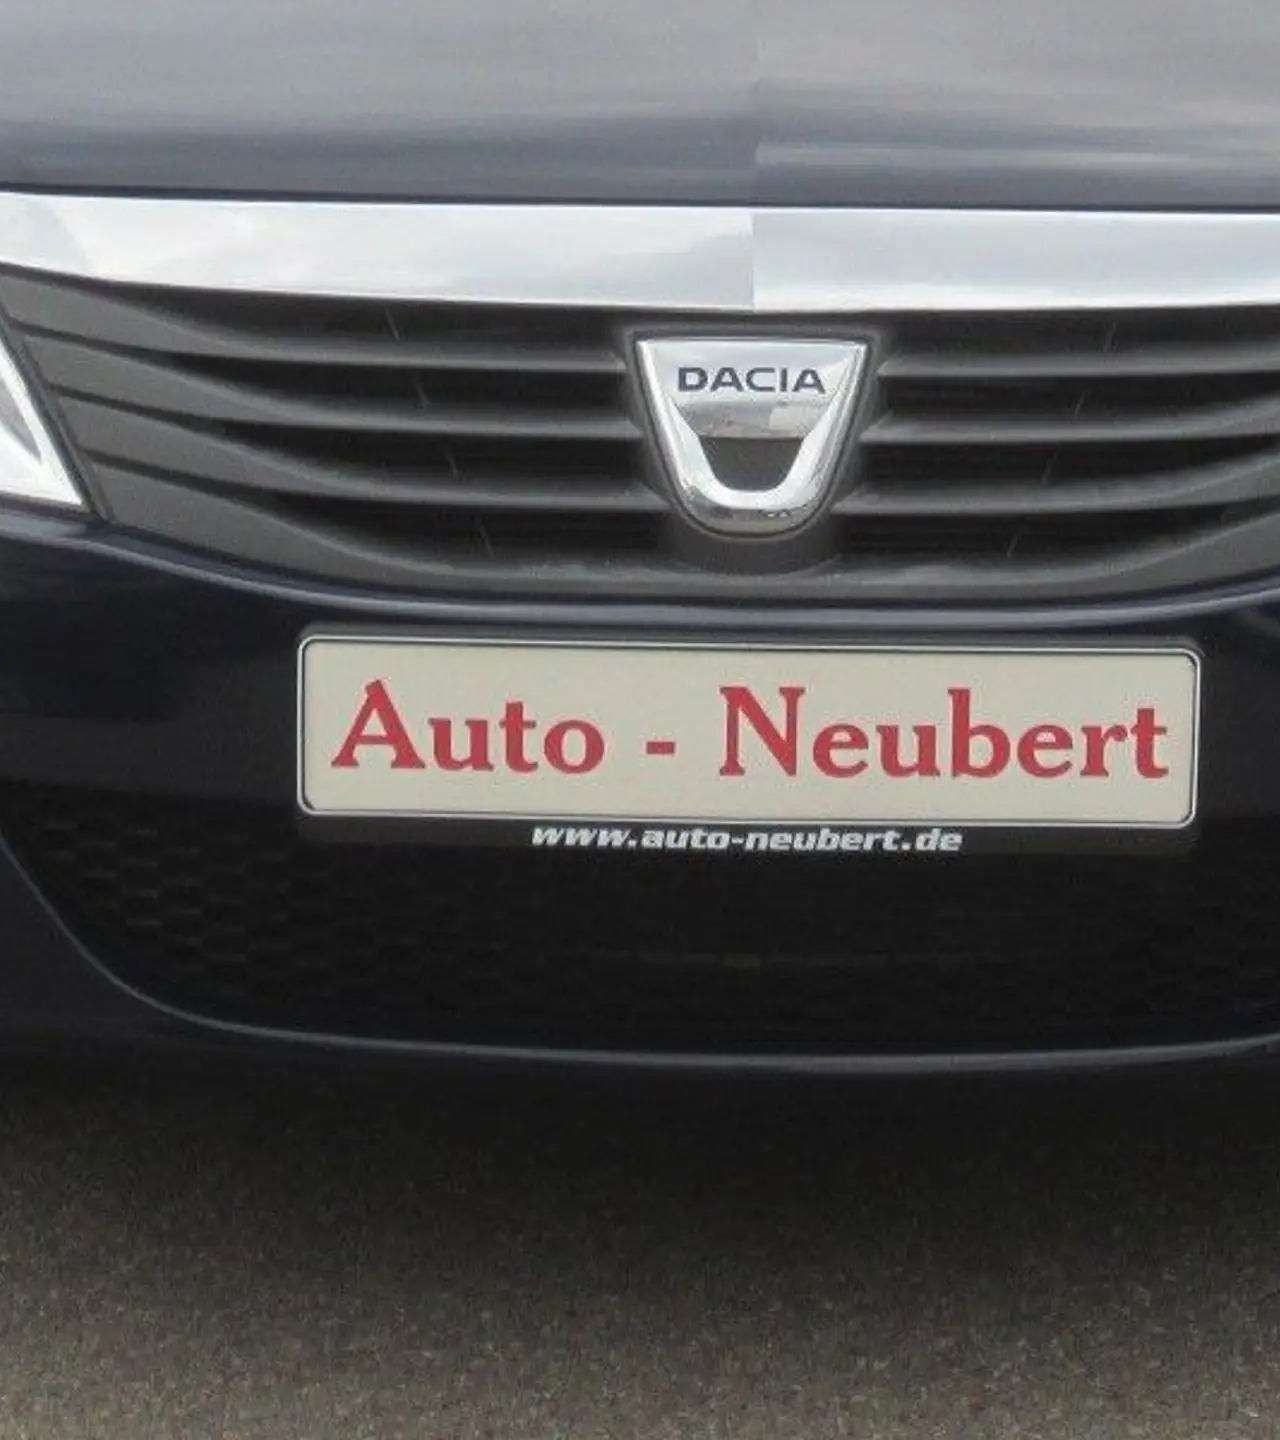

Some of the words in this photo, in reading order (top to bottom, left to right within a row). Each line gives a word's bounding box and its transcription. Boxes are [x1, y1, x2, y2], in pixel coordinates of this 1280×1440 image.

[677, 366, 826, 394] DACIA
[331, 678, 606, 774] Auto
[646, 740, 676, 756] -
[719, 685, 1170, 780] Neubert
[531, 825, 963, 852] www.auto-neubert.de
